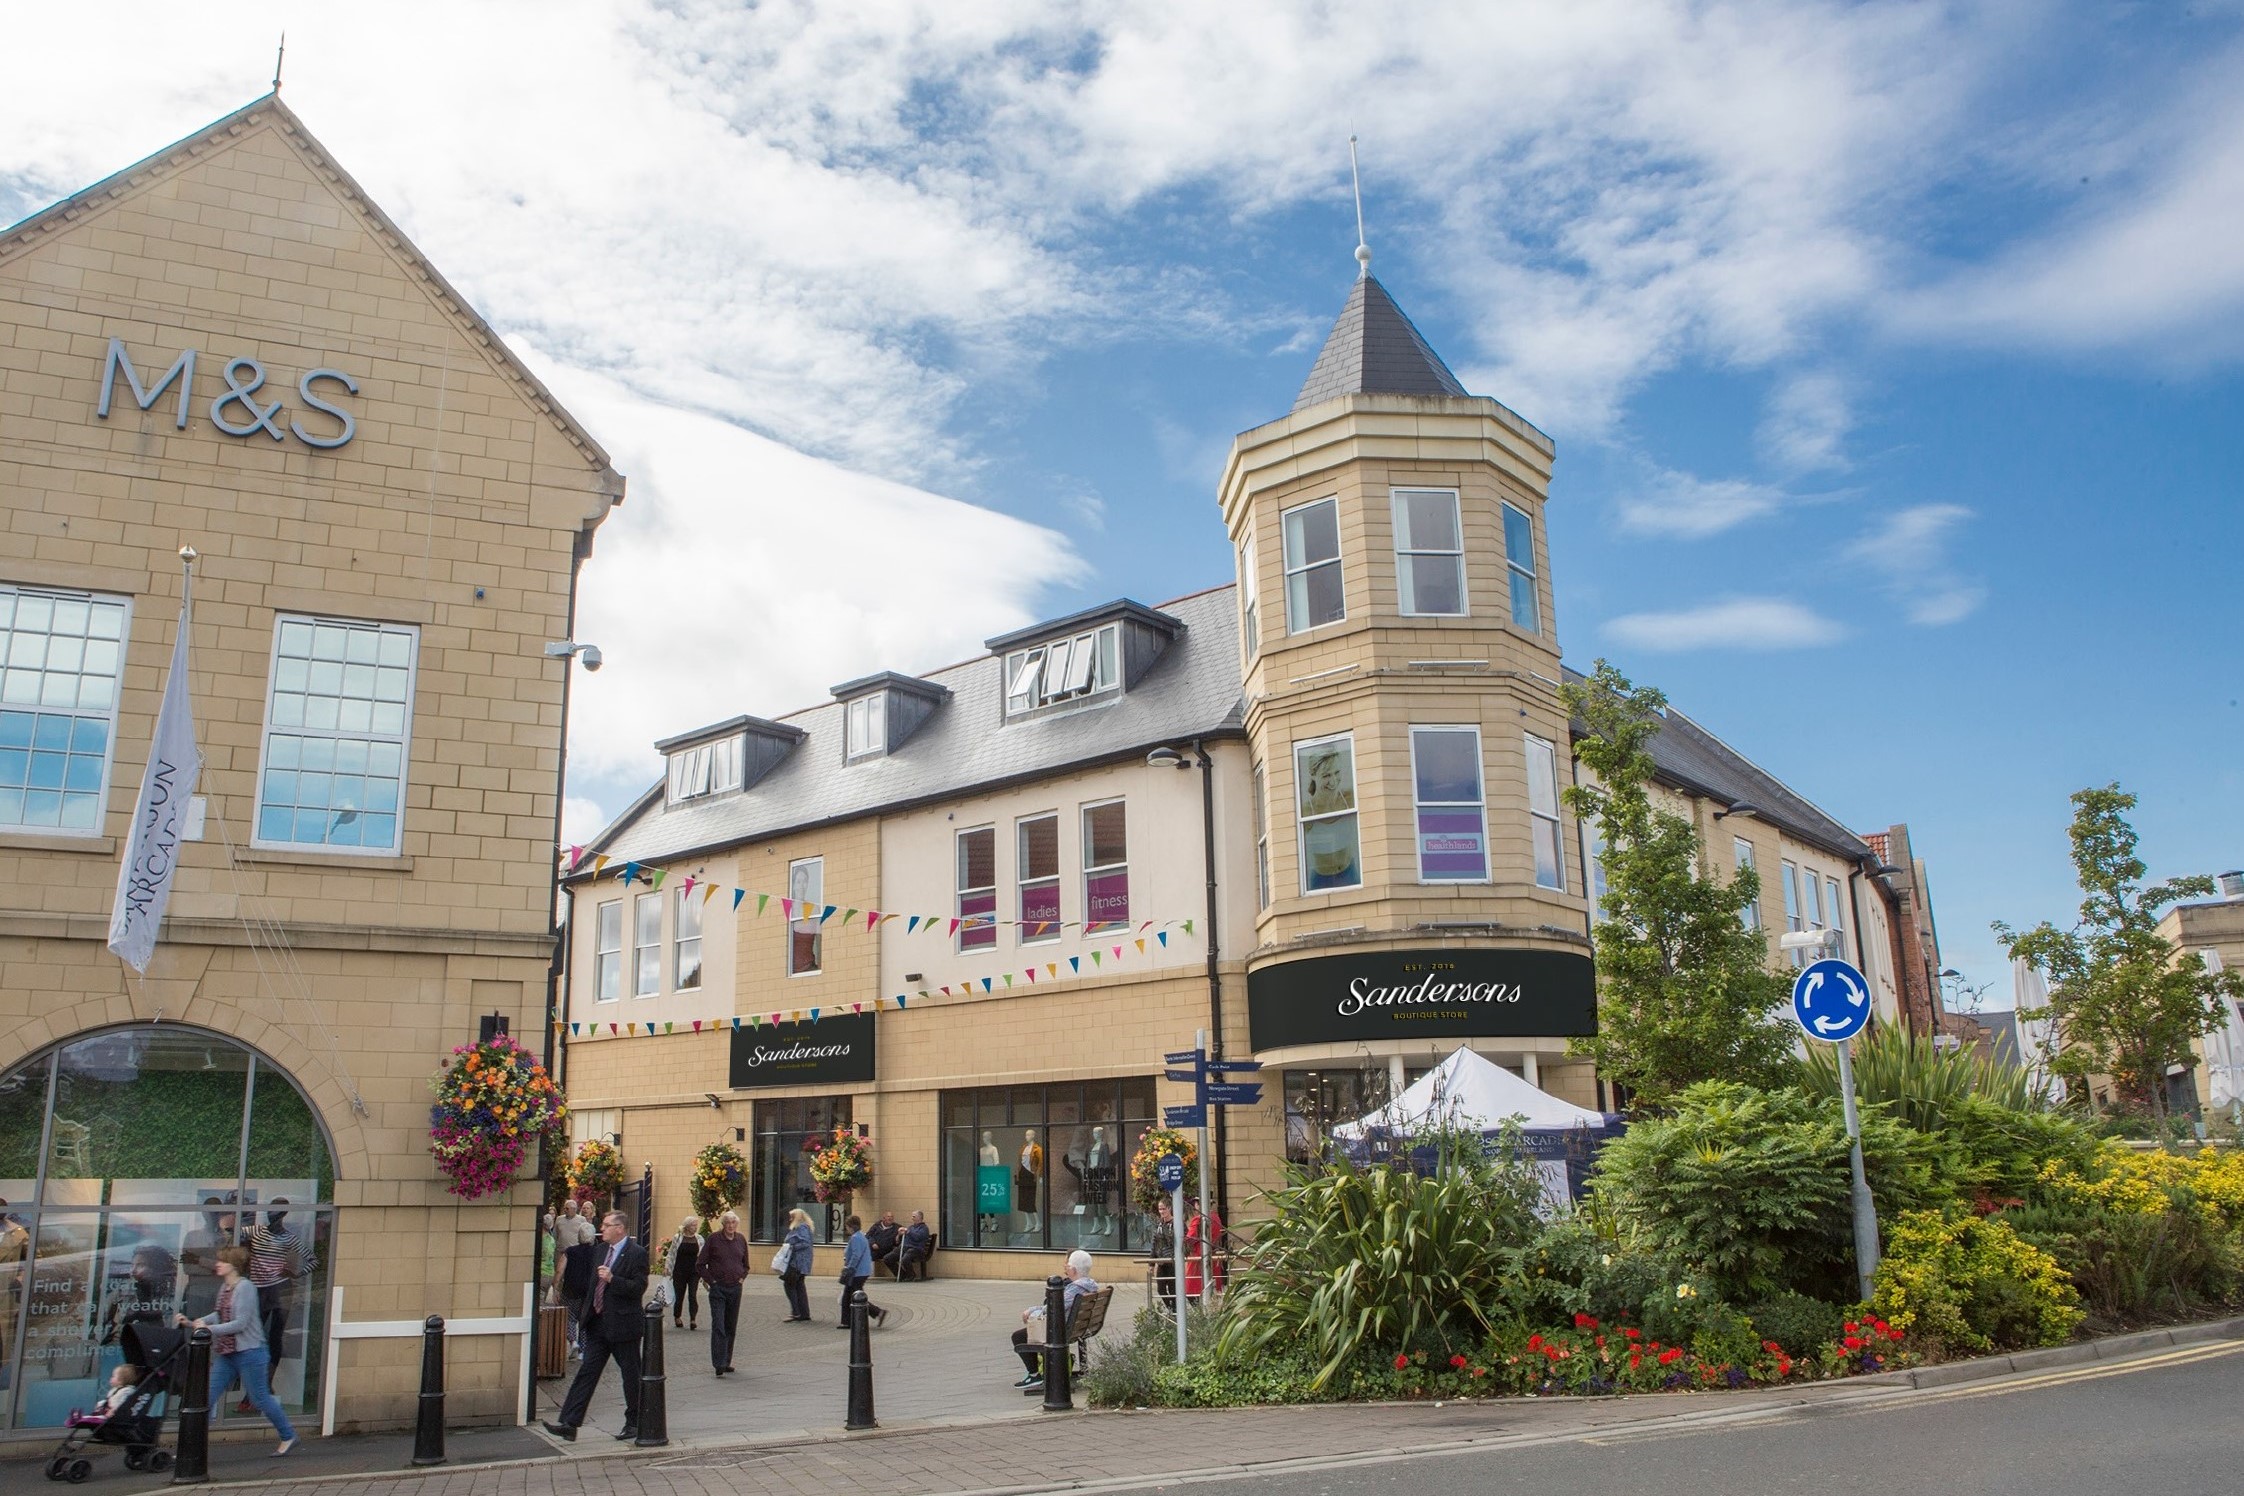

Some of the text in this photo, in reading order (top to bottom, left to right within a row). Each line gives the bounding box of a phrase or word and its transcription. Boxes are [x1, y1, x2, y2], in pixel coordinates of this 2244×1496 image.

[97, 335, 359, 449] M&S
[1091, 894, 1128, 911] fitness
[1027, 905, 1058, 920] ladies
[1338, 973, 1521, 1016] Sandersons
[1392, 1011, 1468, 1020] BOUTIQUE STORE
[748, 1042, 850, 1067] Sandersons
[1084, 1180, 1119, 1192] FASHION
[33, 1278, 72, 1293] Find
[31, 1301, 69, 1315] that
[28, 1327, 38, 1338] a
